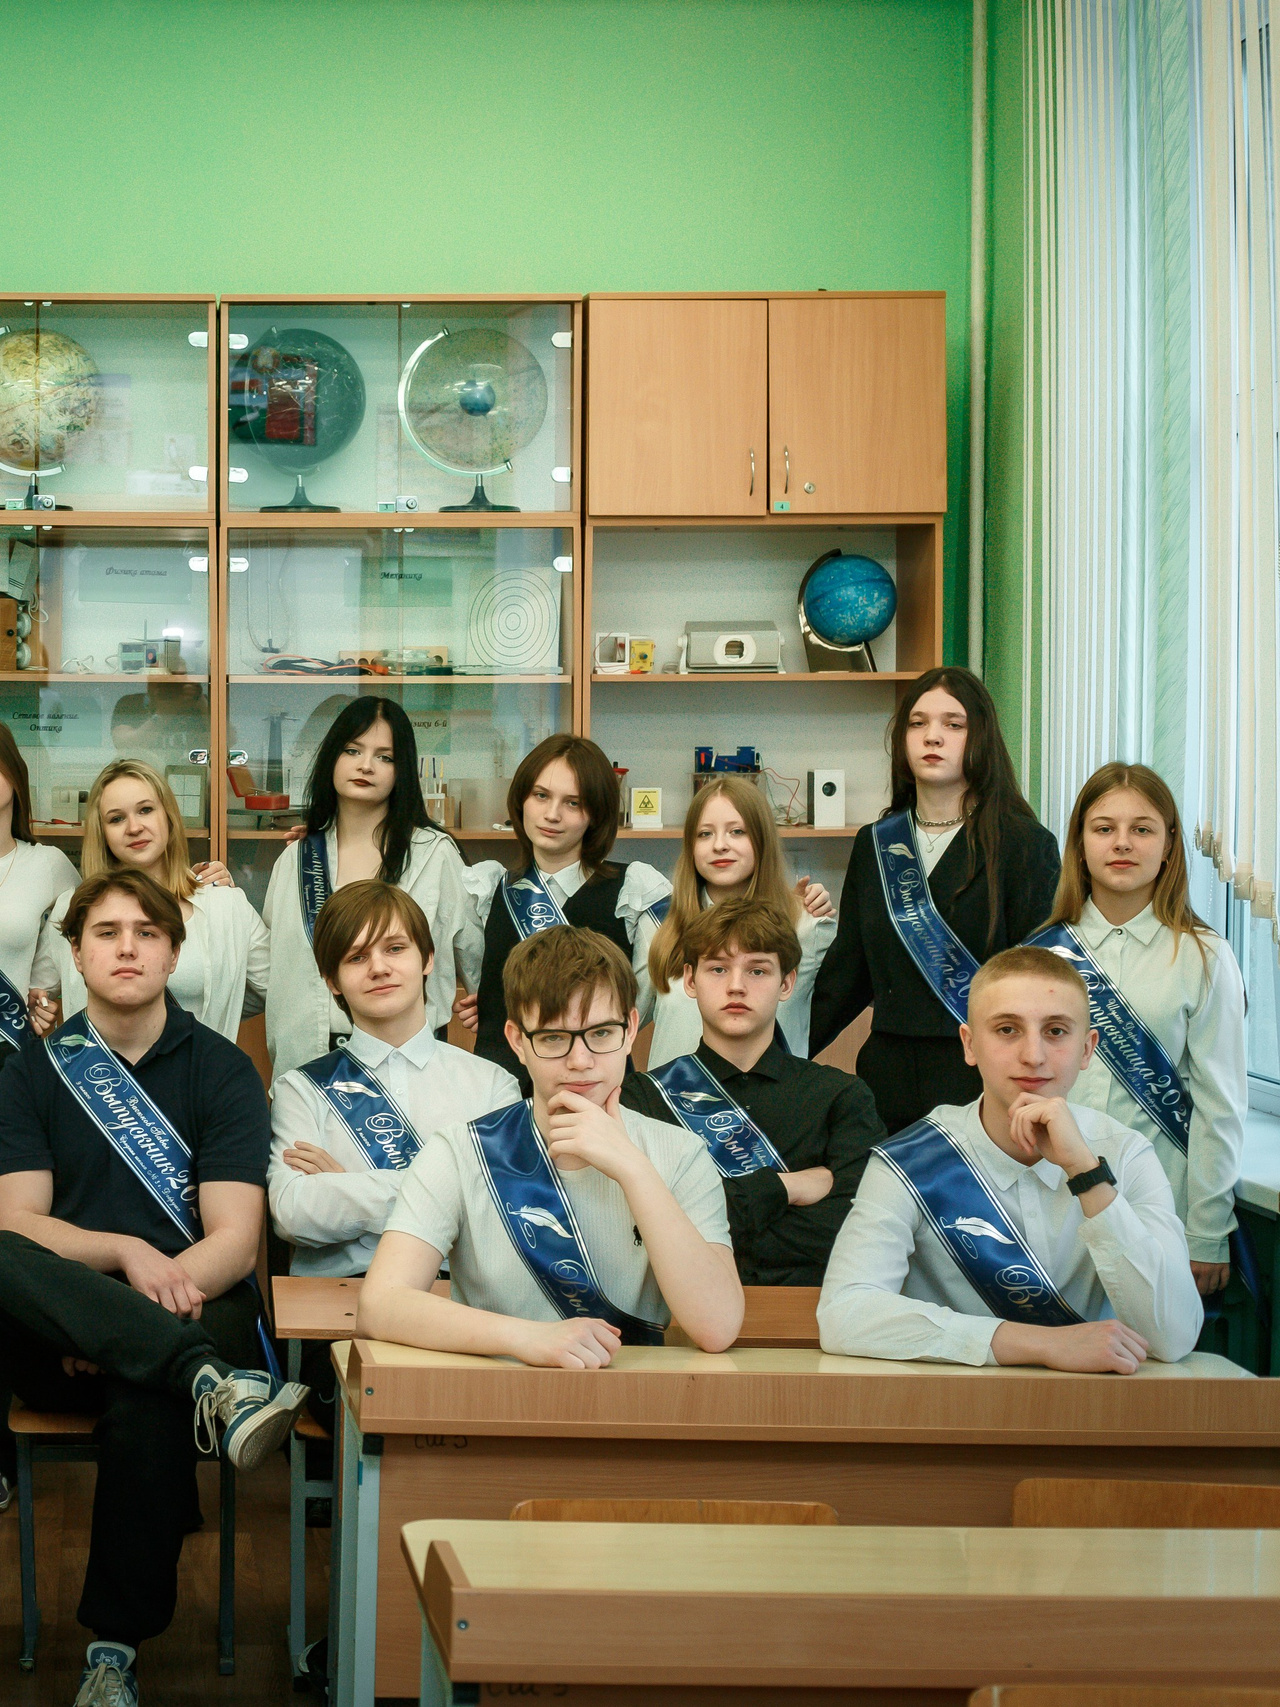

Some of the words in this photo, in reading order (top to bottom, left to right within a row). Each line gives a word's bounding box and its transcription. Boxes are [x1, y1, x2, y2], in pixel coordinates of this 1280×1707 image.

[105, 566, 138, 577] Физика
[140, 569, 168, 577] атома
[380, 572, 423, 581] Механика
[29, 724, 63, 733] Оптика
[897, 868, 955, 975] Выпускница
[83, 1062, 176, 1175] Выпускник
[150, 1125, 170, 1151] Павел
